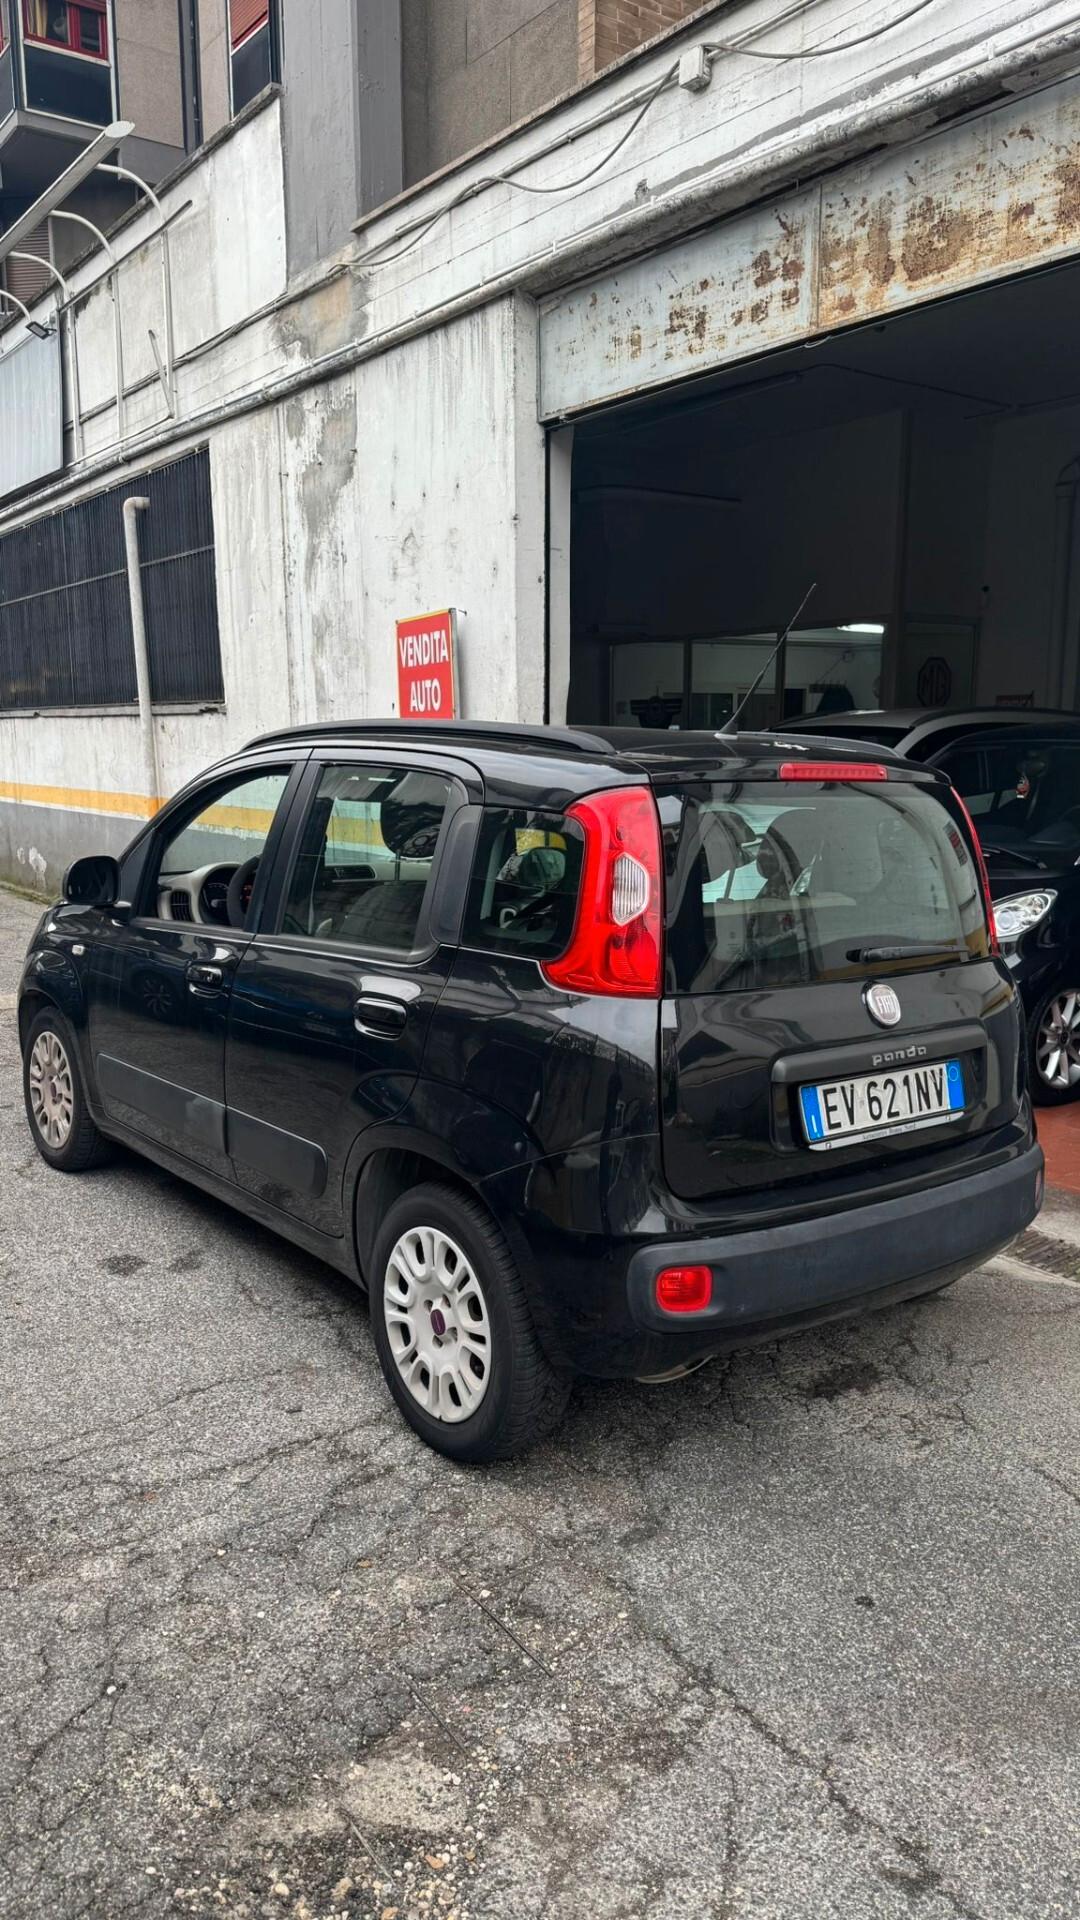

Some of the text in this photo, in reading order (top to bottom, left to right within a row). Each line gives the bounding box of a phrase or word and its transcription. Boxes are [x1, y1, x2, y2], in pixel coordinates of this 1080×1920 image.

[399, 629, 449, 668] VENDITA
[410, 677, 442, 713] AUTO
[871, 1045, 927, 1066] panda
[823, 1067, 944, 1130] EV 621NV
